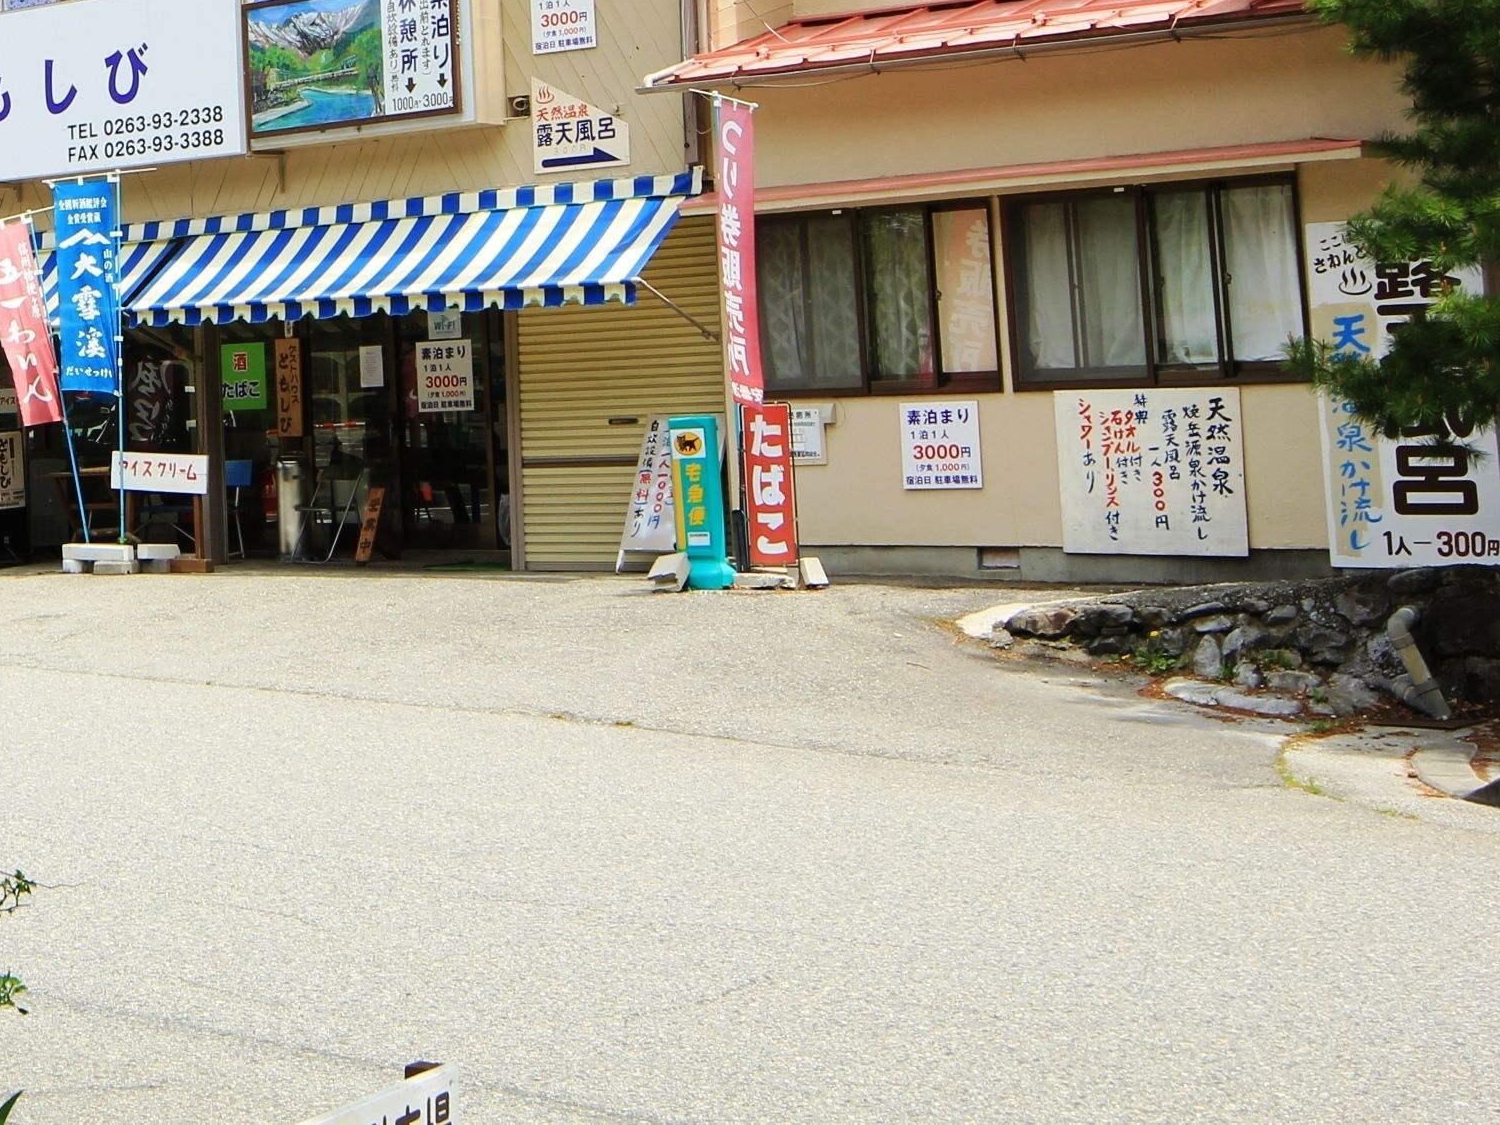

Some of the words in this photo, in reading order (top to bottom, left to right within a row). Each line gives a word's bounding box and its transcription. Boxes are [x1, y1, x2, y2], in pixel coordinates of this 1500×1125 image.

[540, 10, 588, 28] 3000円
[68, 123, 98, 140] TEL
[103, 106, 223, 136] 0263-93-2338
[536, 103, 589, 122] 天然温泉
[68, 145, 99, 163] FAX
[104, 129, 224, 158] 0263-93-3388
[537, 116, 616, 148] 露天風呂
[233, 353, 248, 371] 酒
[421, 345, 466, 361] 素泊まり
[222, 380, 260, 399] たばこ
[278, 353, 292, 434] ともしび
[425, 374, 468, 389] 3000円
[907, 408, 969, 425] 素泊まり
[910, 429, 949, 440] 1泊1人
[1078, 399, 1097, 494] シャワーあり
[1124, 410, 1142, 482] タオル付き
[1162, 409, 1181, 480] 露天風呂
[1207, 397, 1234, 495] 天然温泉
[913, 444, 971, 460] 3000円
[750, 414, 789, 555] たばこ
[1182, 404, 1212, 540] 焼岳源泉かけ流し
